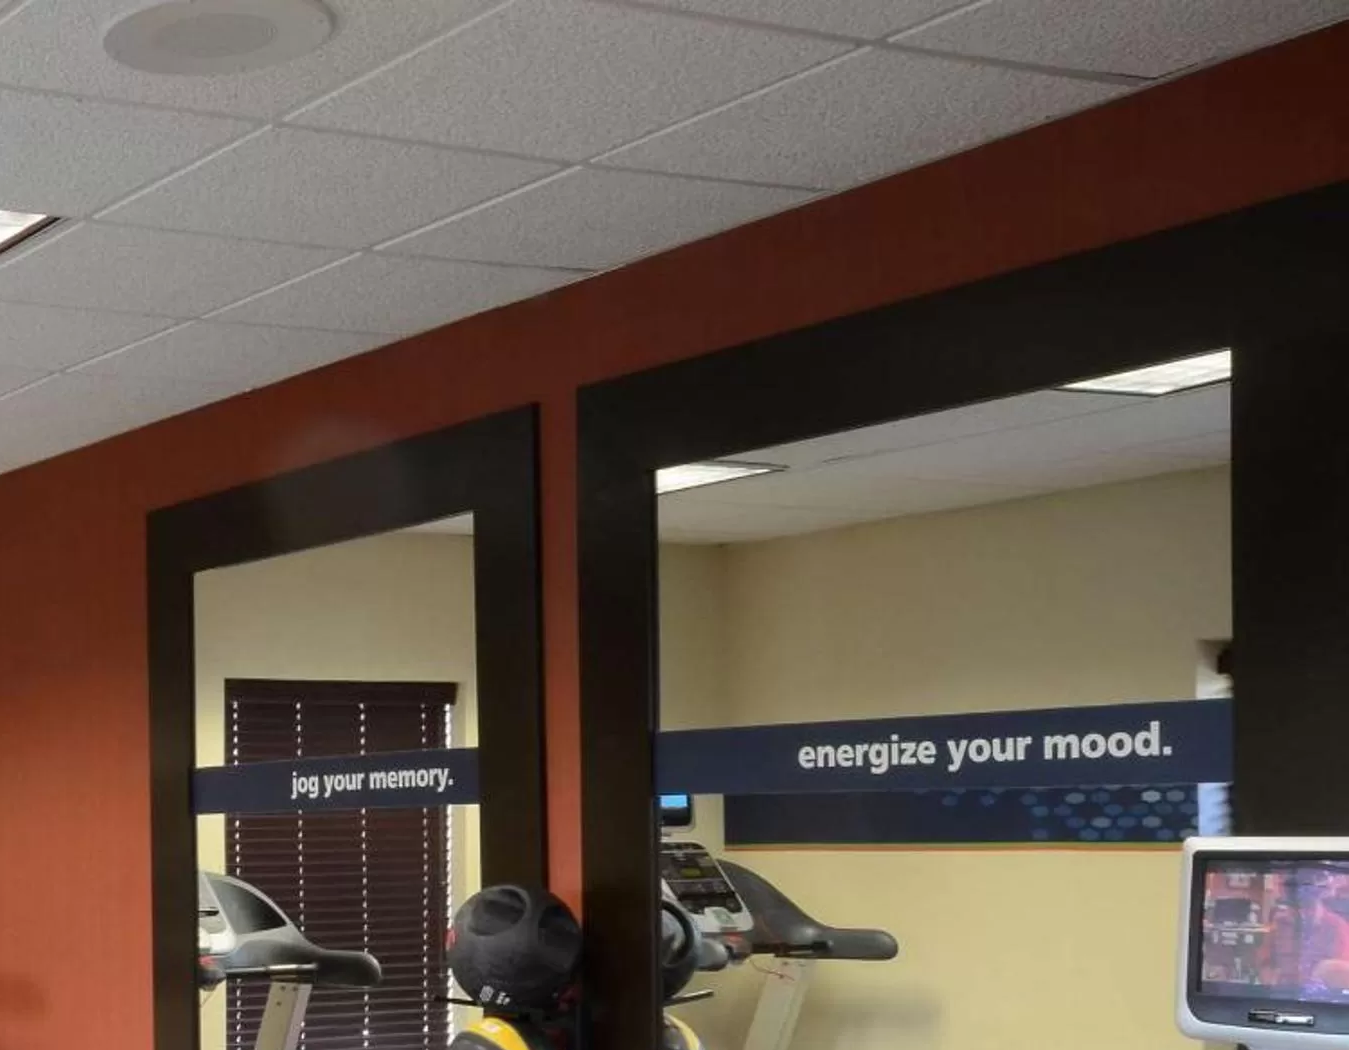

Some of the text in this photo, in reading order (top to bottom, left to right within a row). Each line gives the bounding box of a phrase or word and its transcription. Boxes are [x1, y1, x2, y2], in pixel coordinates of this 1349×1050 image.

[798, 721, 1173, 774] energize your mood.
[291, 767, 454, 800] jog your memory.
